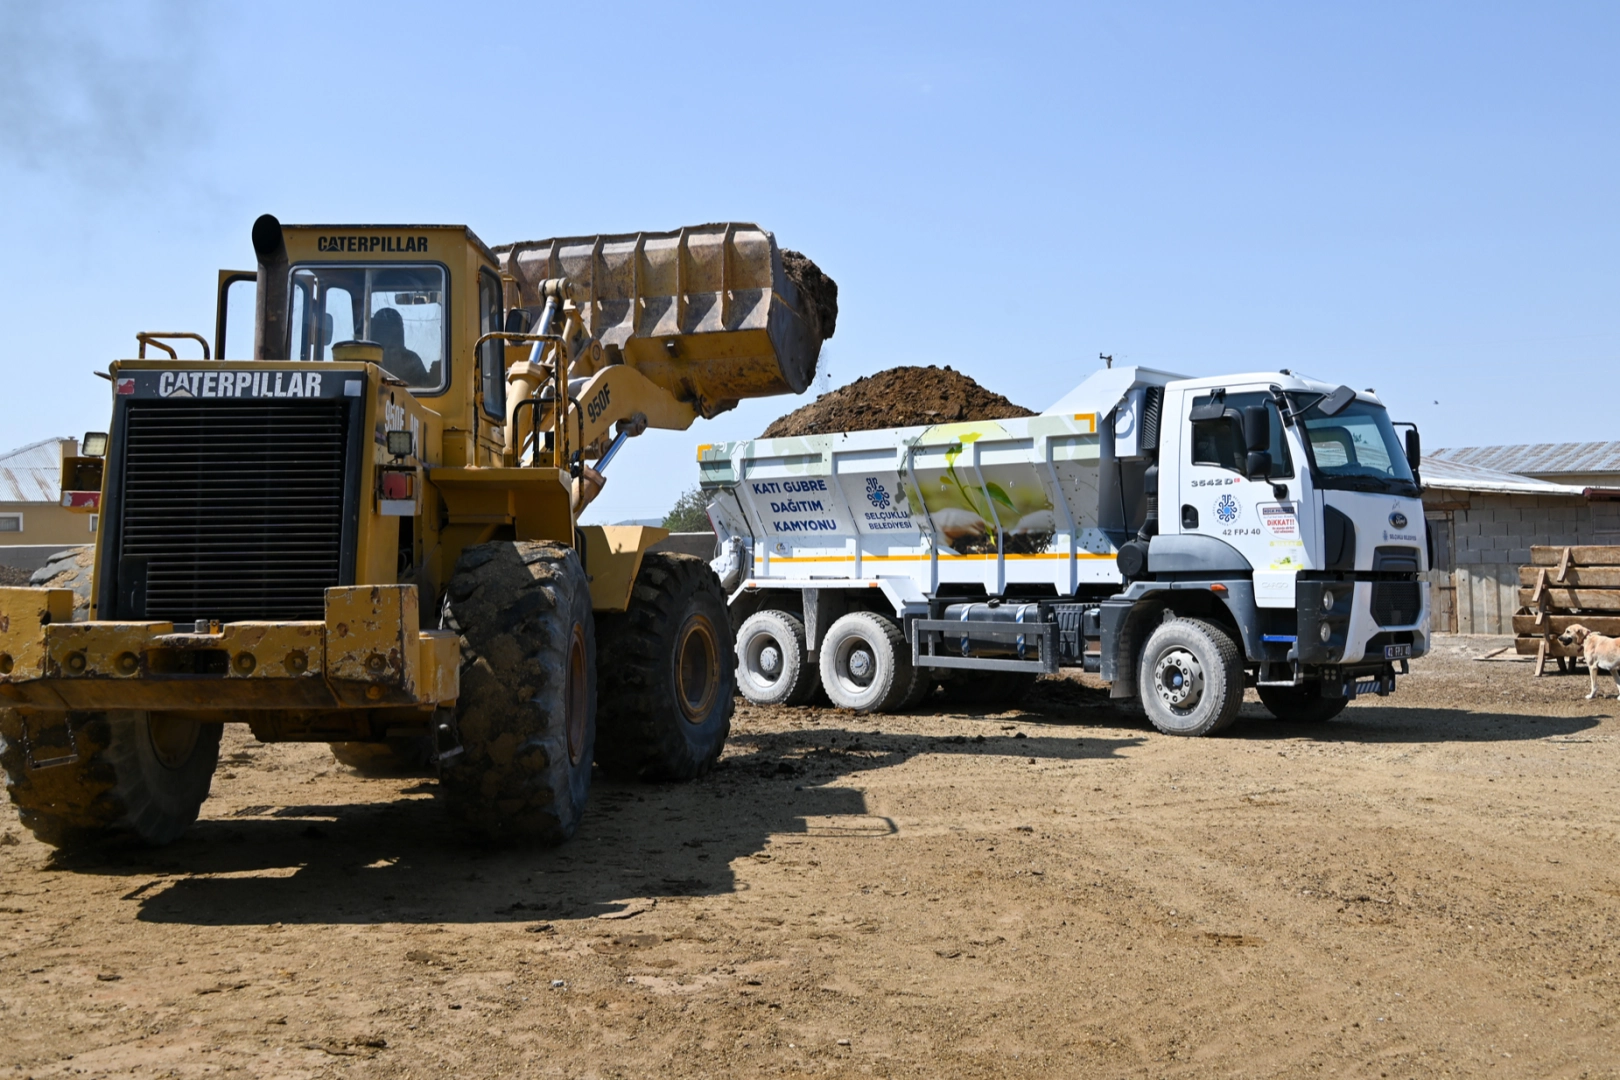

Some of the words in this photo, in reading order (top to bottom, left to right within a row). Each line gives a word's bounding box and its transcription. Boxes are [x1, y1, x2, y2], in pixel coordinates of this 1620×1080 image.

[318, 236, 428, 252] CATERPILLAR
[158, 371, 322, 398] CATERPILLAR
[587, 382, 611, 424] 950F
[752, 482, 782, 494] KATI
[1191, 479, 1223, 488] 3542
[770, 498, 824, 513] DAĞITIM
[864, 511, 909, 521] SELÇUKLU
[772, 519, 837, 532] KAMYONU
[868, 520, 912, 530] BELEDİYESİ
[1234, 528, 1249, 536] FPJ
[1250, 528, 1261, 536] 40
[1388, 646, 1394, 657] 42
[1395, 646, 1404, 656] FPJ
